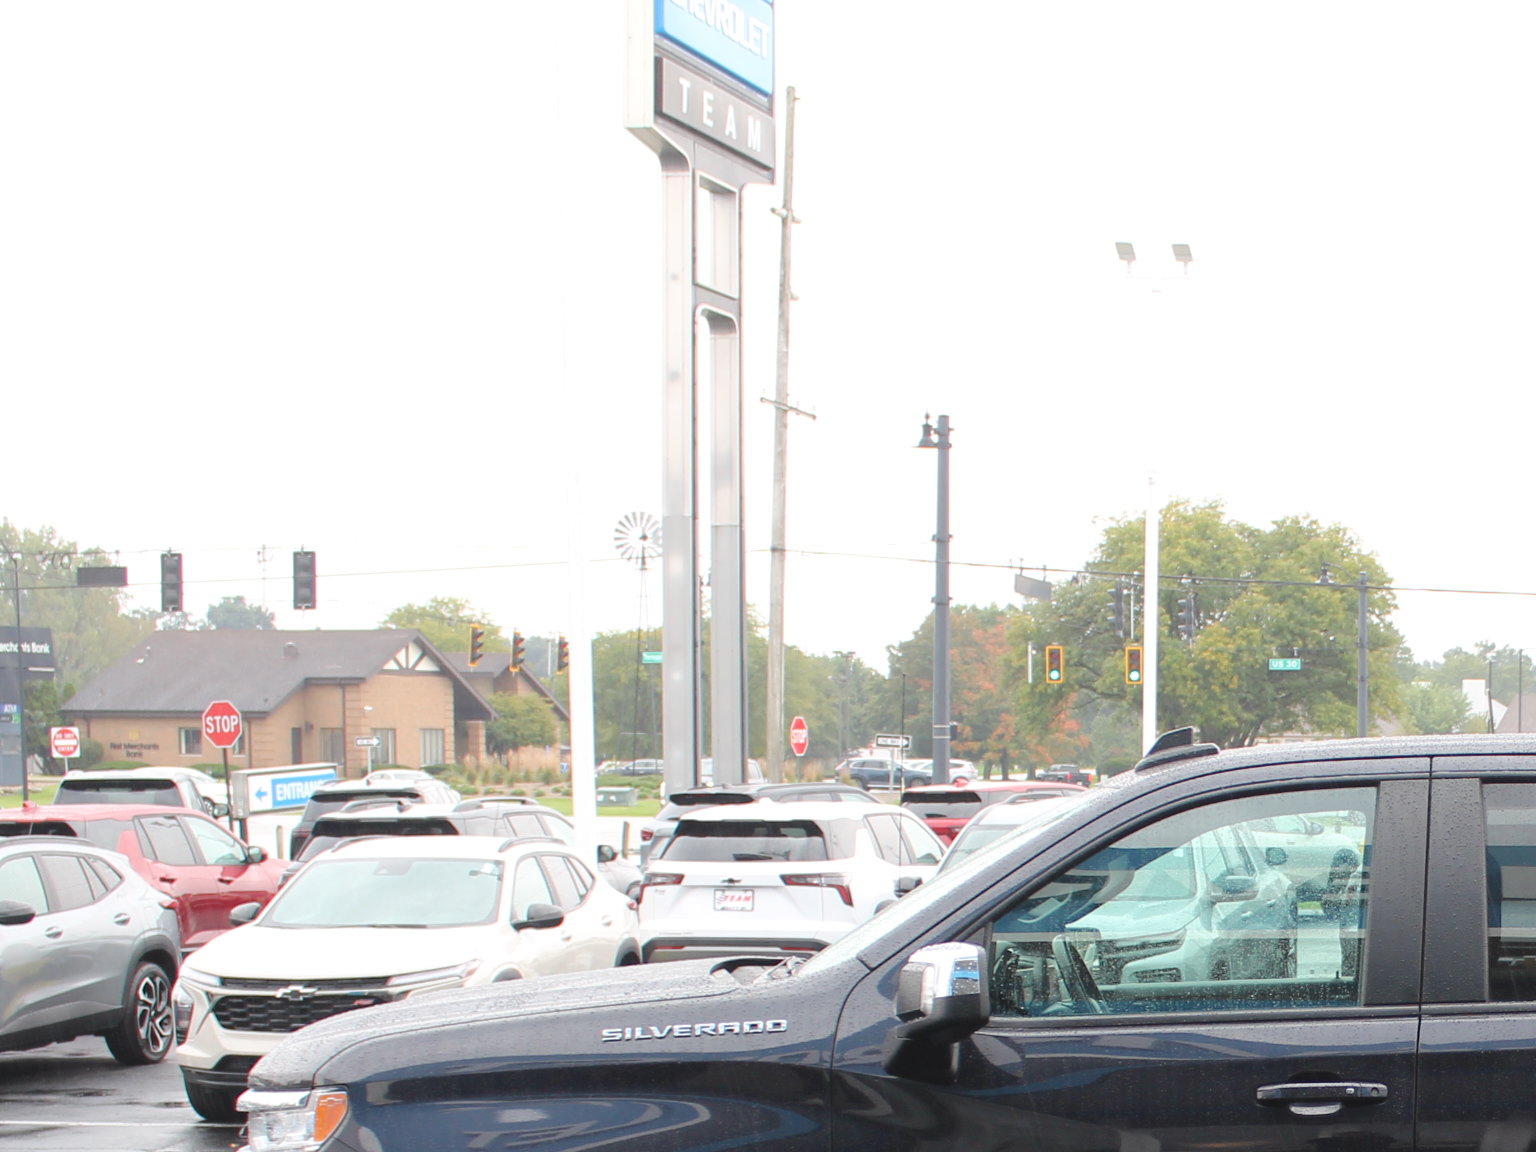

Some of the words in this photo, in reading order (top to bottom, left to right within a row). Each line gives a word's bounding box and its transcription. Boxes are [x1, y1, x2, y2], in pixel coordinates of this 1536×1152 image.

[679, 77, 761, 152] TEAM
[32, 642, 50, 654] Bank
[1272, 660, 1284, 668] US
[1286, 660, 1298, 668] 30
[205, 715, 239, 734] STOP
[790, 729, 808, 743] STOP
[602, 1019, 787, 1042] SILVERADO
